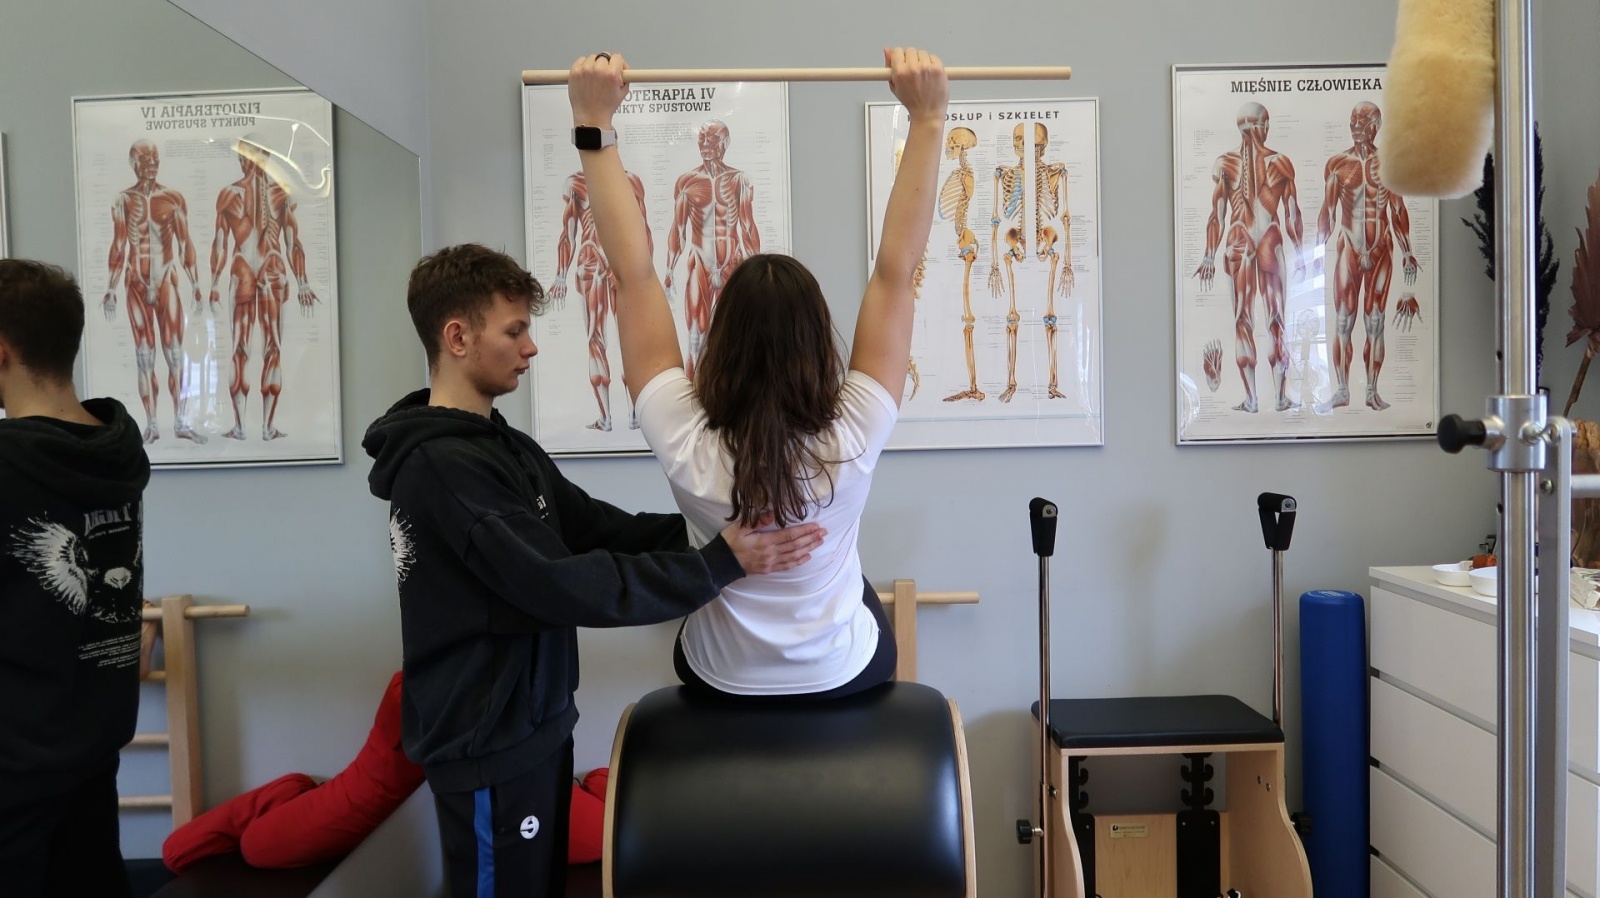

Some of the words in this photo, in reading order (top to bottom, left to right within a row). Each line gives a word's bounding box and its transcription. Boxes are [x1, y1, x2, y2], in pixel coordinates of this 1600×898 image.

[1231, 77, 1292, 95] MIĘŚNIE
[1297, 78, 1383, 92] CZŁOWIEKA
[624, 88, 696, 102] OTERAPIA
[701, 87, 716, 100] IV
[614, 103, 644, 114] NKTY
[648, 102, 711, 113] SPUSTOWE
[998, 111, 1060, 120] SZKIELET
